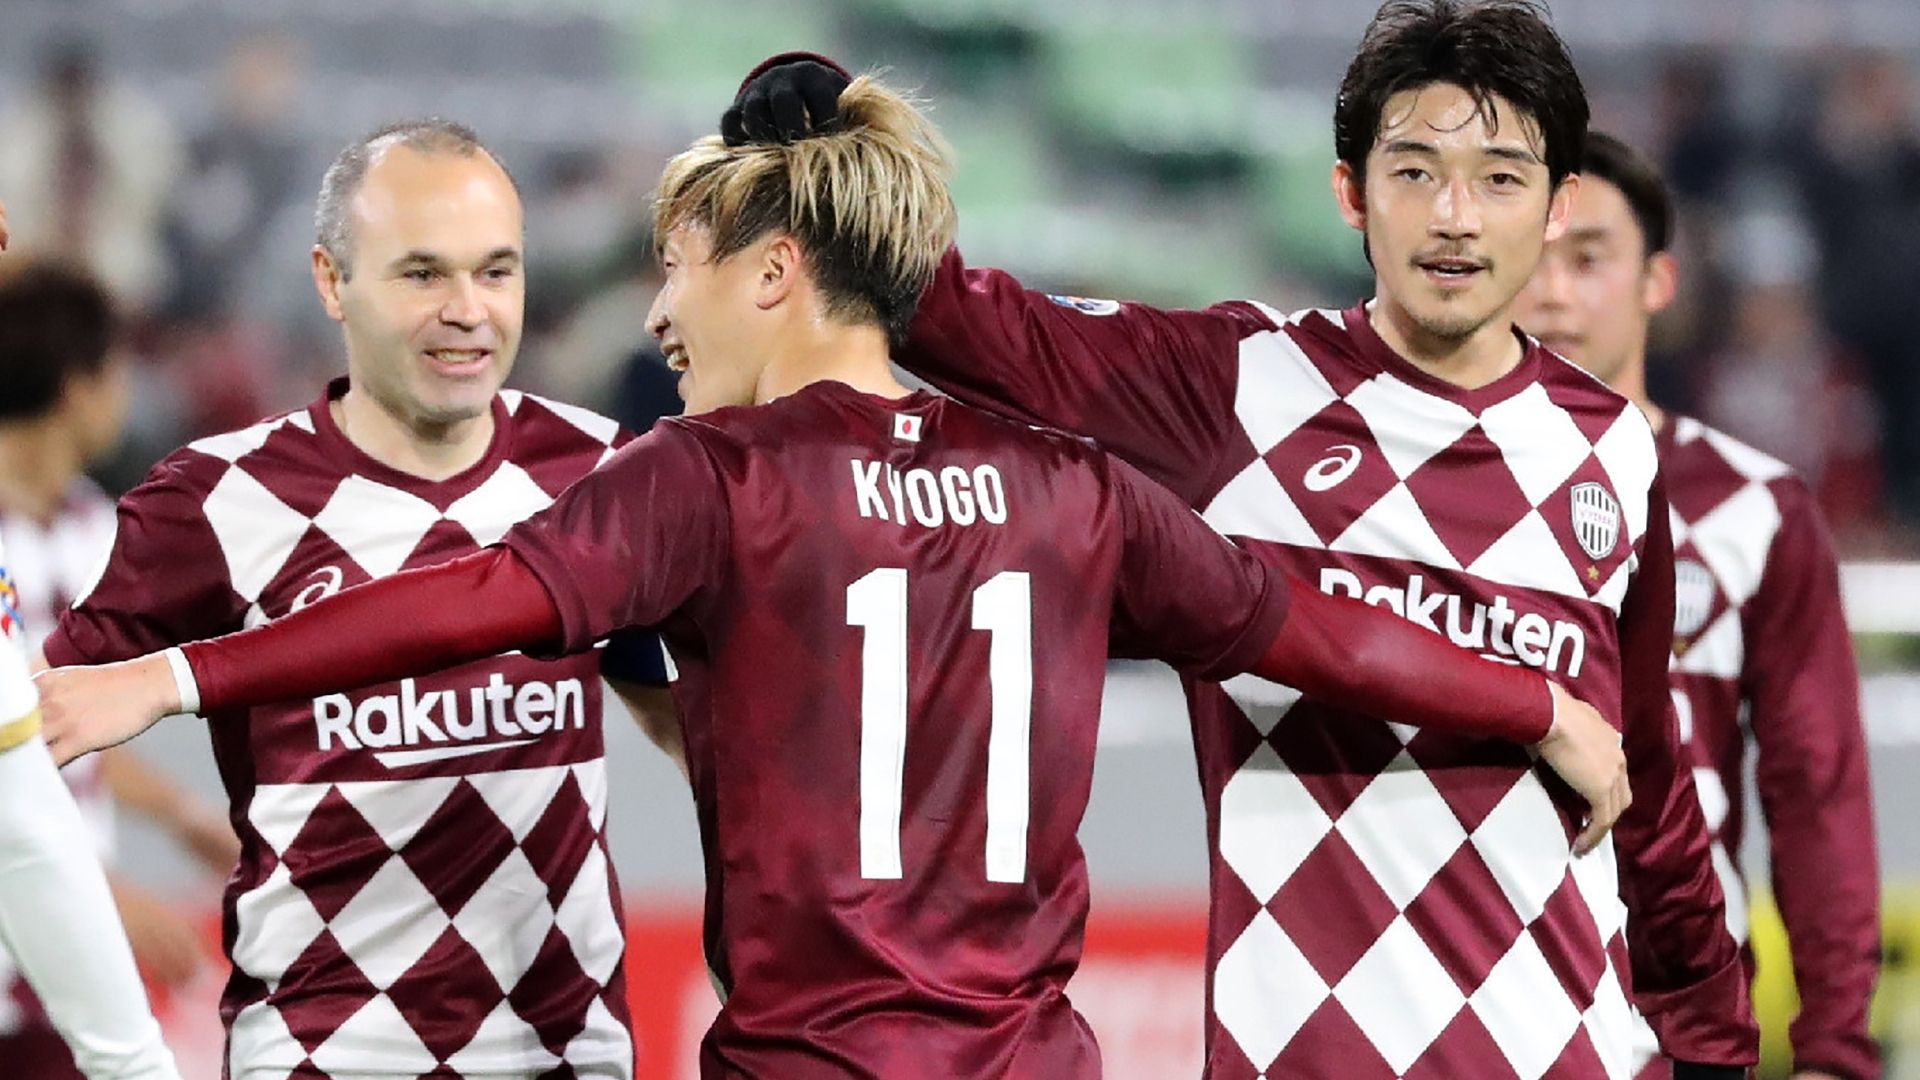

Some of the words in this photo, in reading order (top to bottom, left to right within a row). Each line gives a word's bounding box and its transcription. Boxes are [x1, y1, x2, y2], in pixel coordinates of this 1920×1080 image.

[850, 458, 1008, 528] KYOGO
[312, 672, 585, 751] Rakuten
[846, 567, 1033, 884] 11
